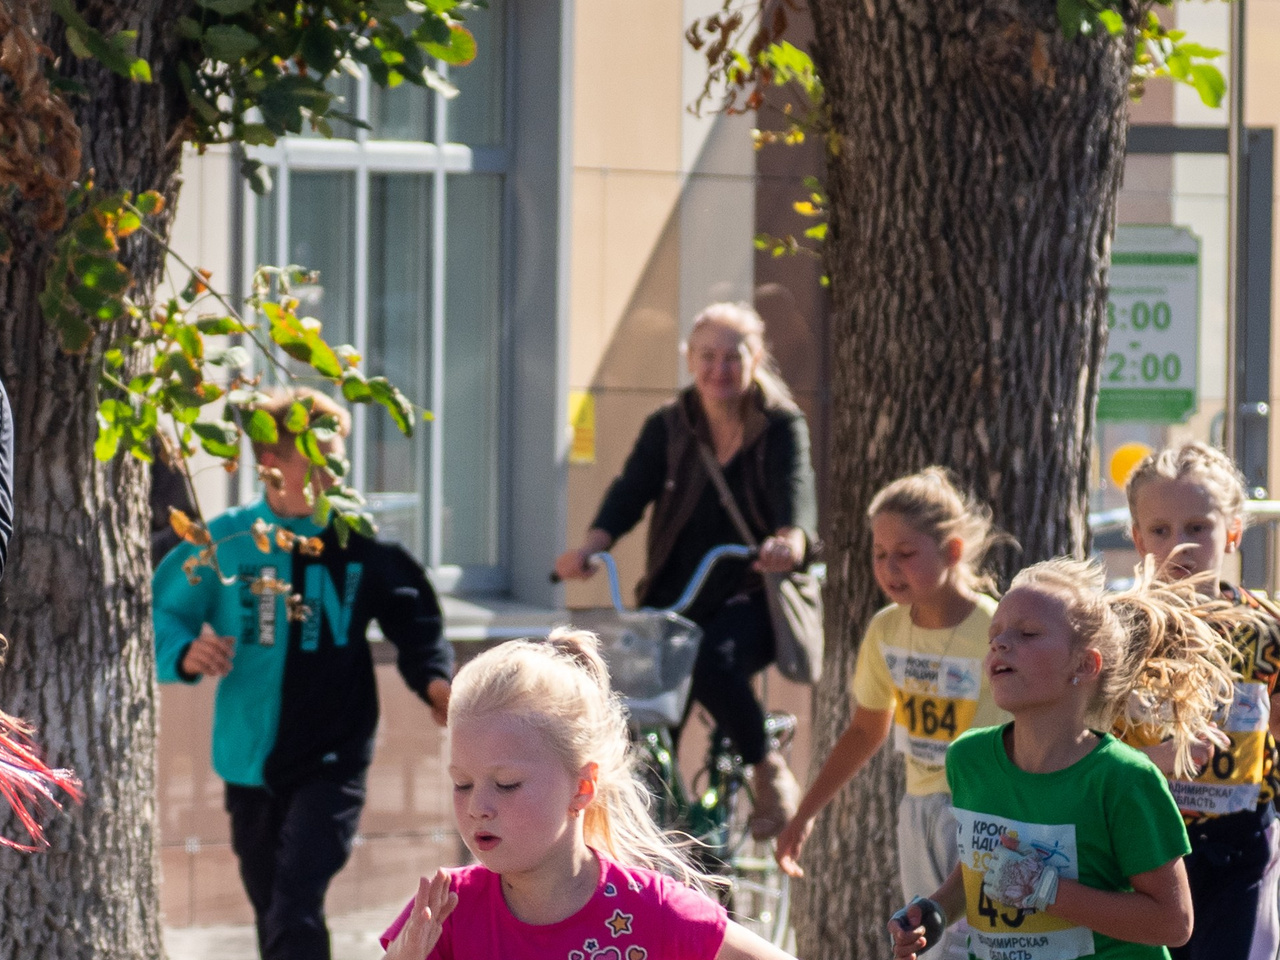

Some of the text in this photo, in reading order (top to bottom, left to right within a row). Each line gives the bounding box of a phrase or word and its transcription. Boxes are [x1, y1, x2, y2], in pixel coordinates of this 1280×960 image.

[1101, 353, 1181, 382] 2:00
[904, 696, 958, 738] 164
[1169, 782, 1235, 799] АДИМИРСКА
[971, 835, 1000, 851] НАЦ
[972, 850, 992, 870] 20
